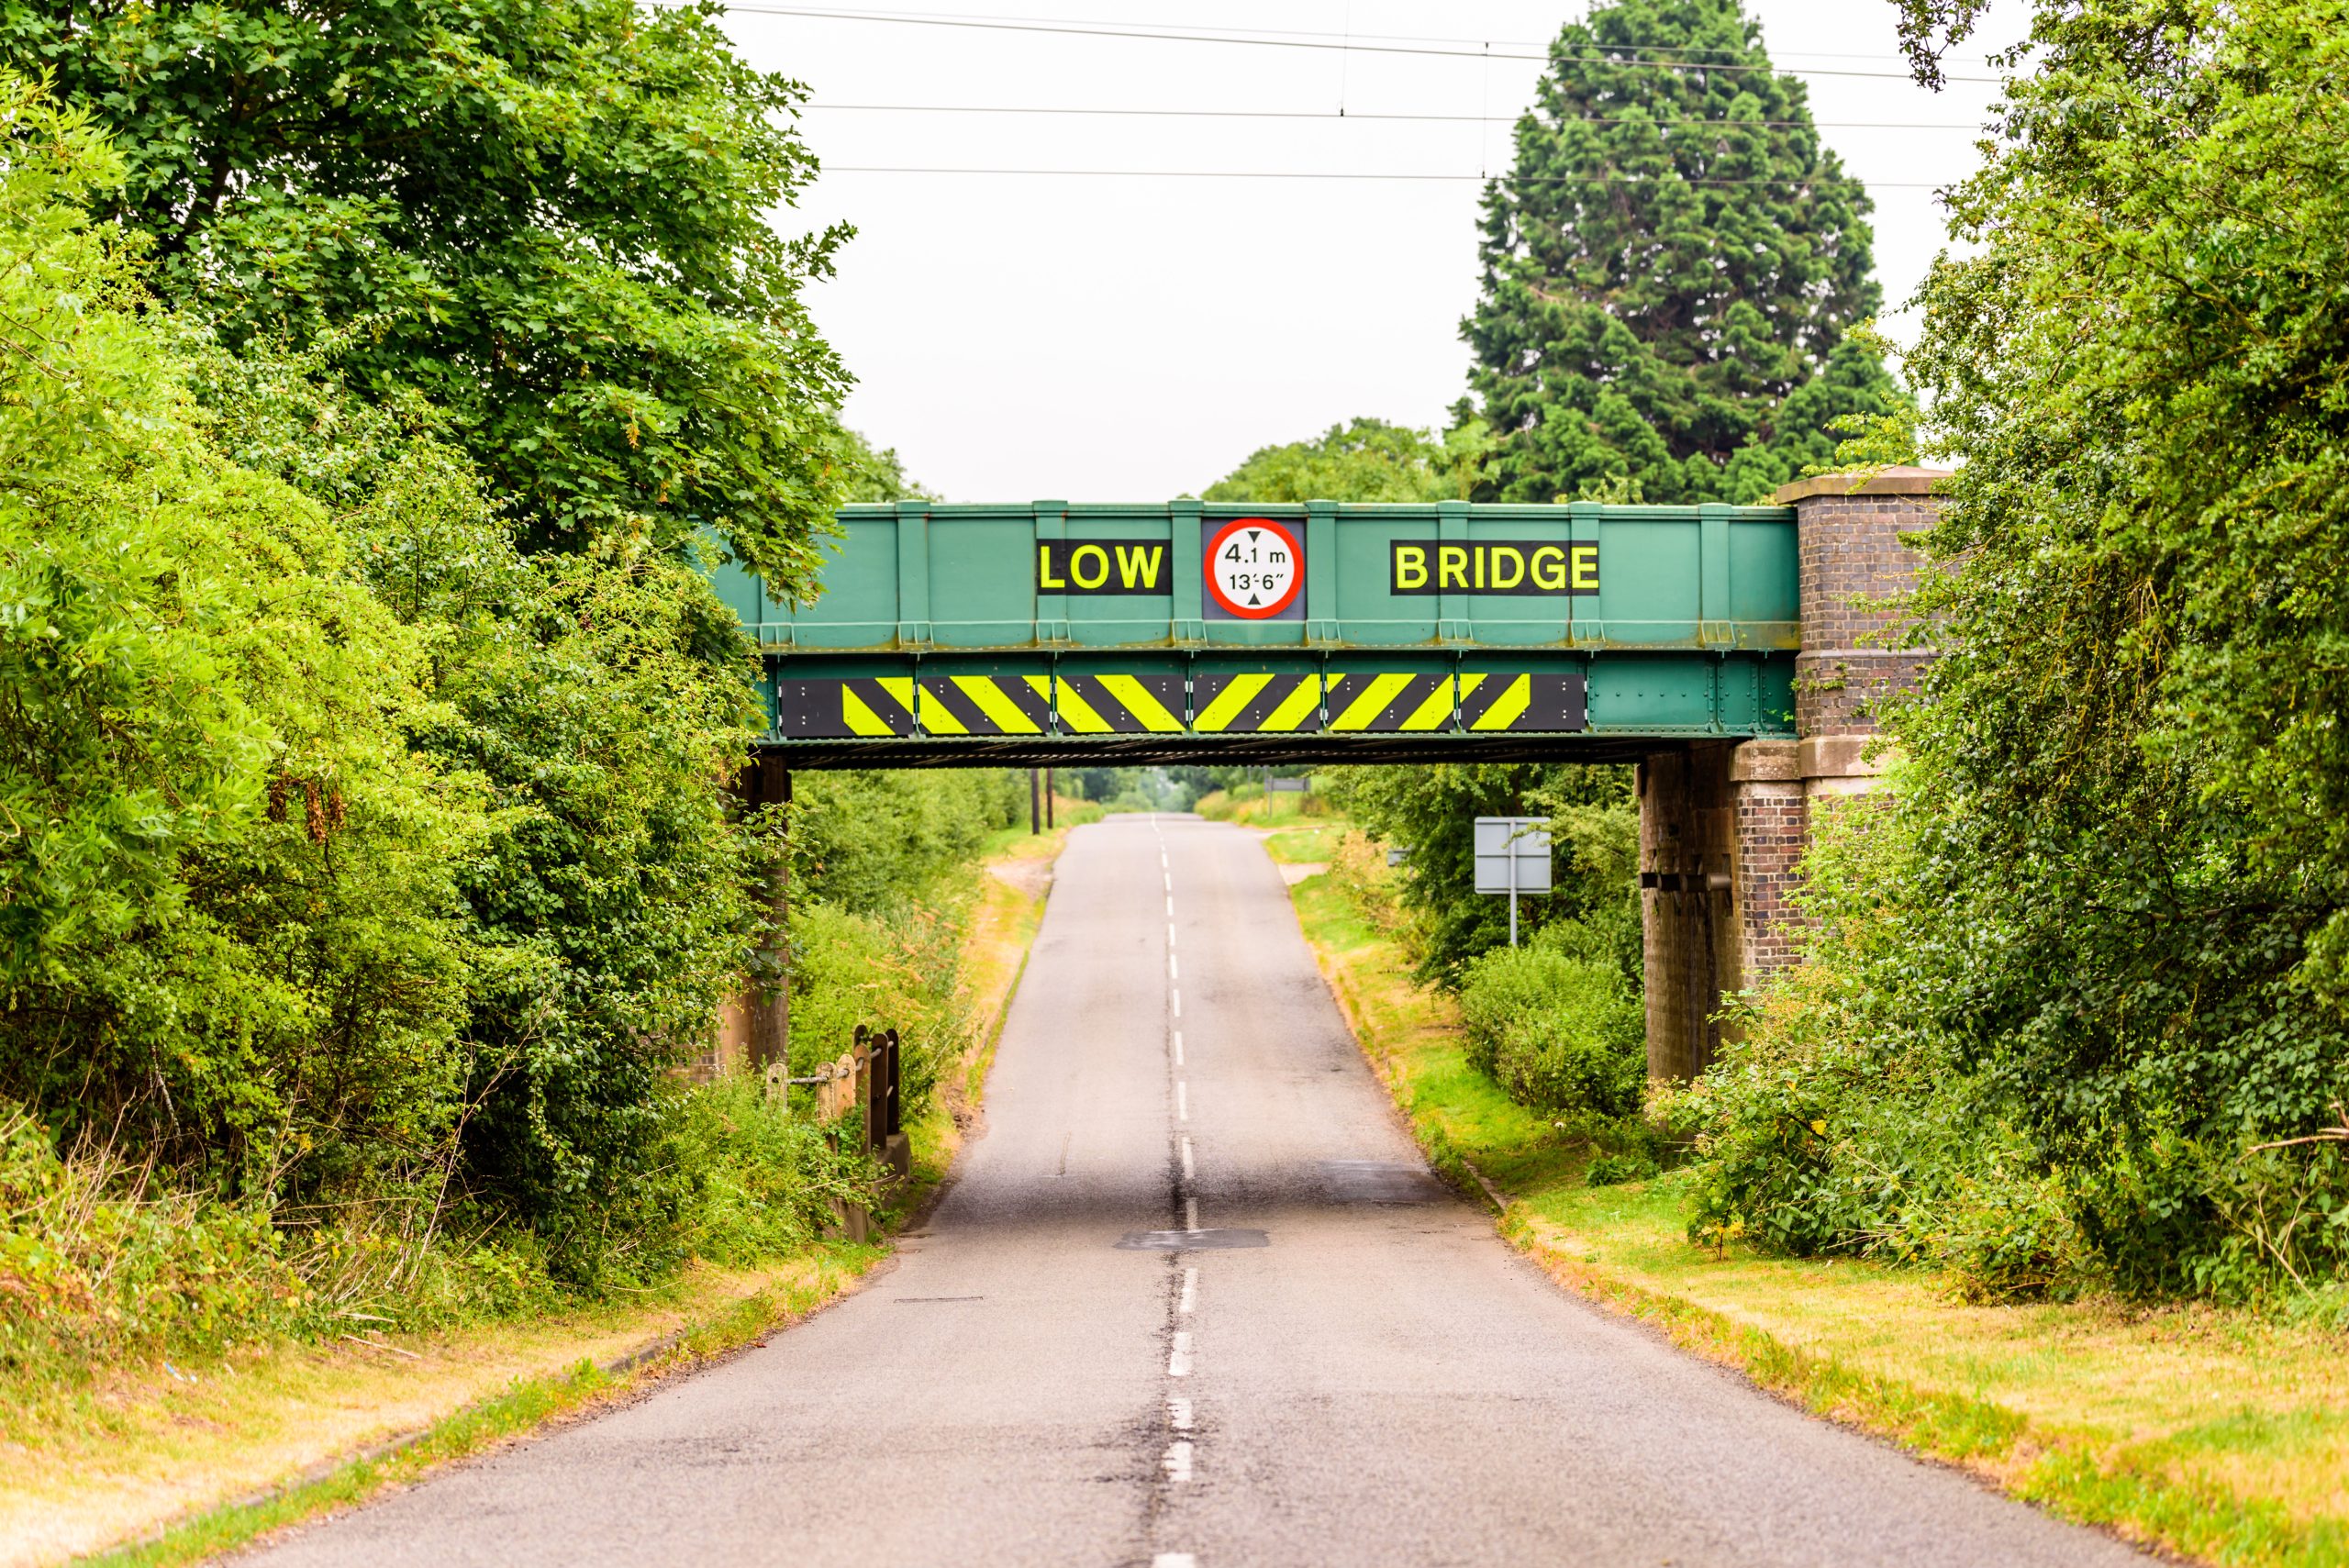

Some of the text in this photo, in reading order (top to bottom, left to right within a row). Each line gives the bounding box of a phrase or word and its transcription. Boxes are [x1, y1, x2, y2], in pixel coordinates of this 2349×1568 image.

[1040, 544, 1599, 590] LOW BRIDGE
[1224, 543, 1286, 563] 4.1 m
